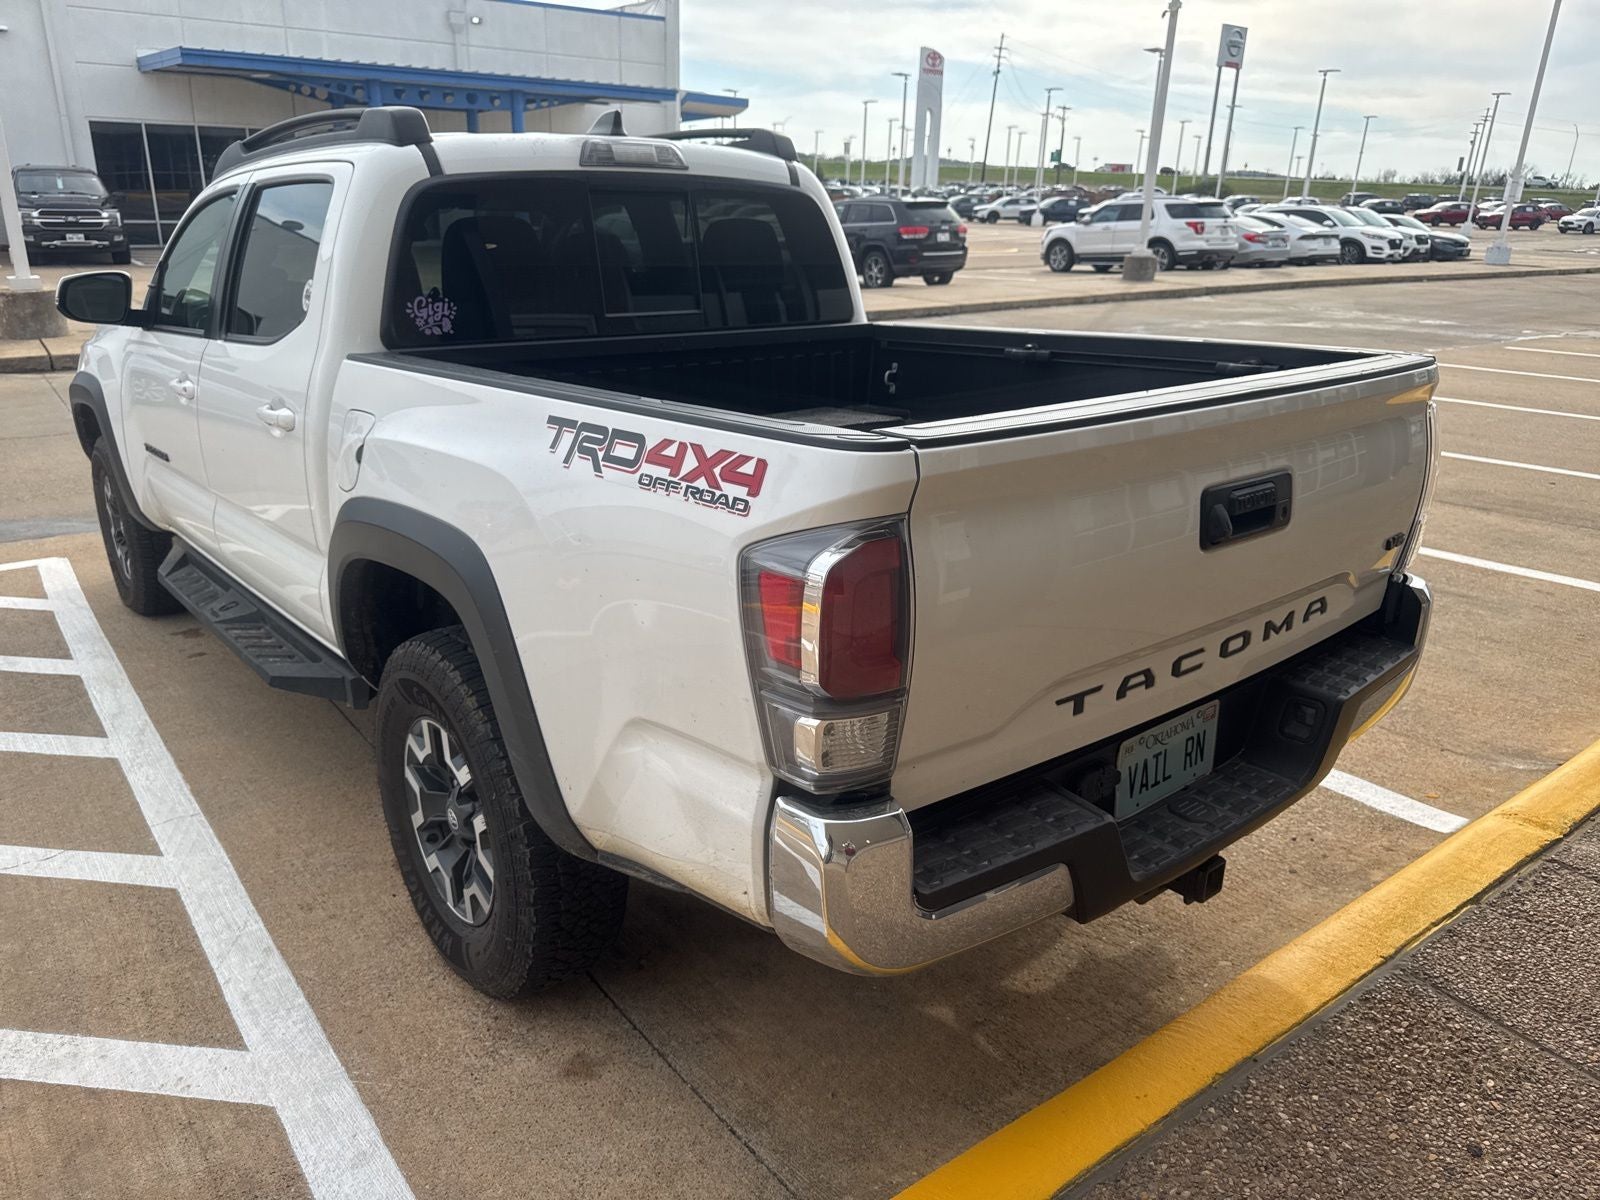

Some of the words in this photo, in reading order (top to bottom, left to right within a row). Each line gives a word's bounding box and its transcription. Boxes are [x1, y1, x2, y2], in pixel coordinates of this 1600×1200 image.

[413, 296, 451, 321] Gigi
[546, 414, 648, 478] TRD
[637, 472, 683, 496] OFF
[682, 483, 751, 517] ROAD
[1055, 596, 1328, 717] TACOMA
[1145, 715, 1195, 750] OKLAHOMA
[1128, 748, 1172, 799] VAIL
[1183, 729, 1206, 772] RN
